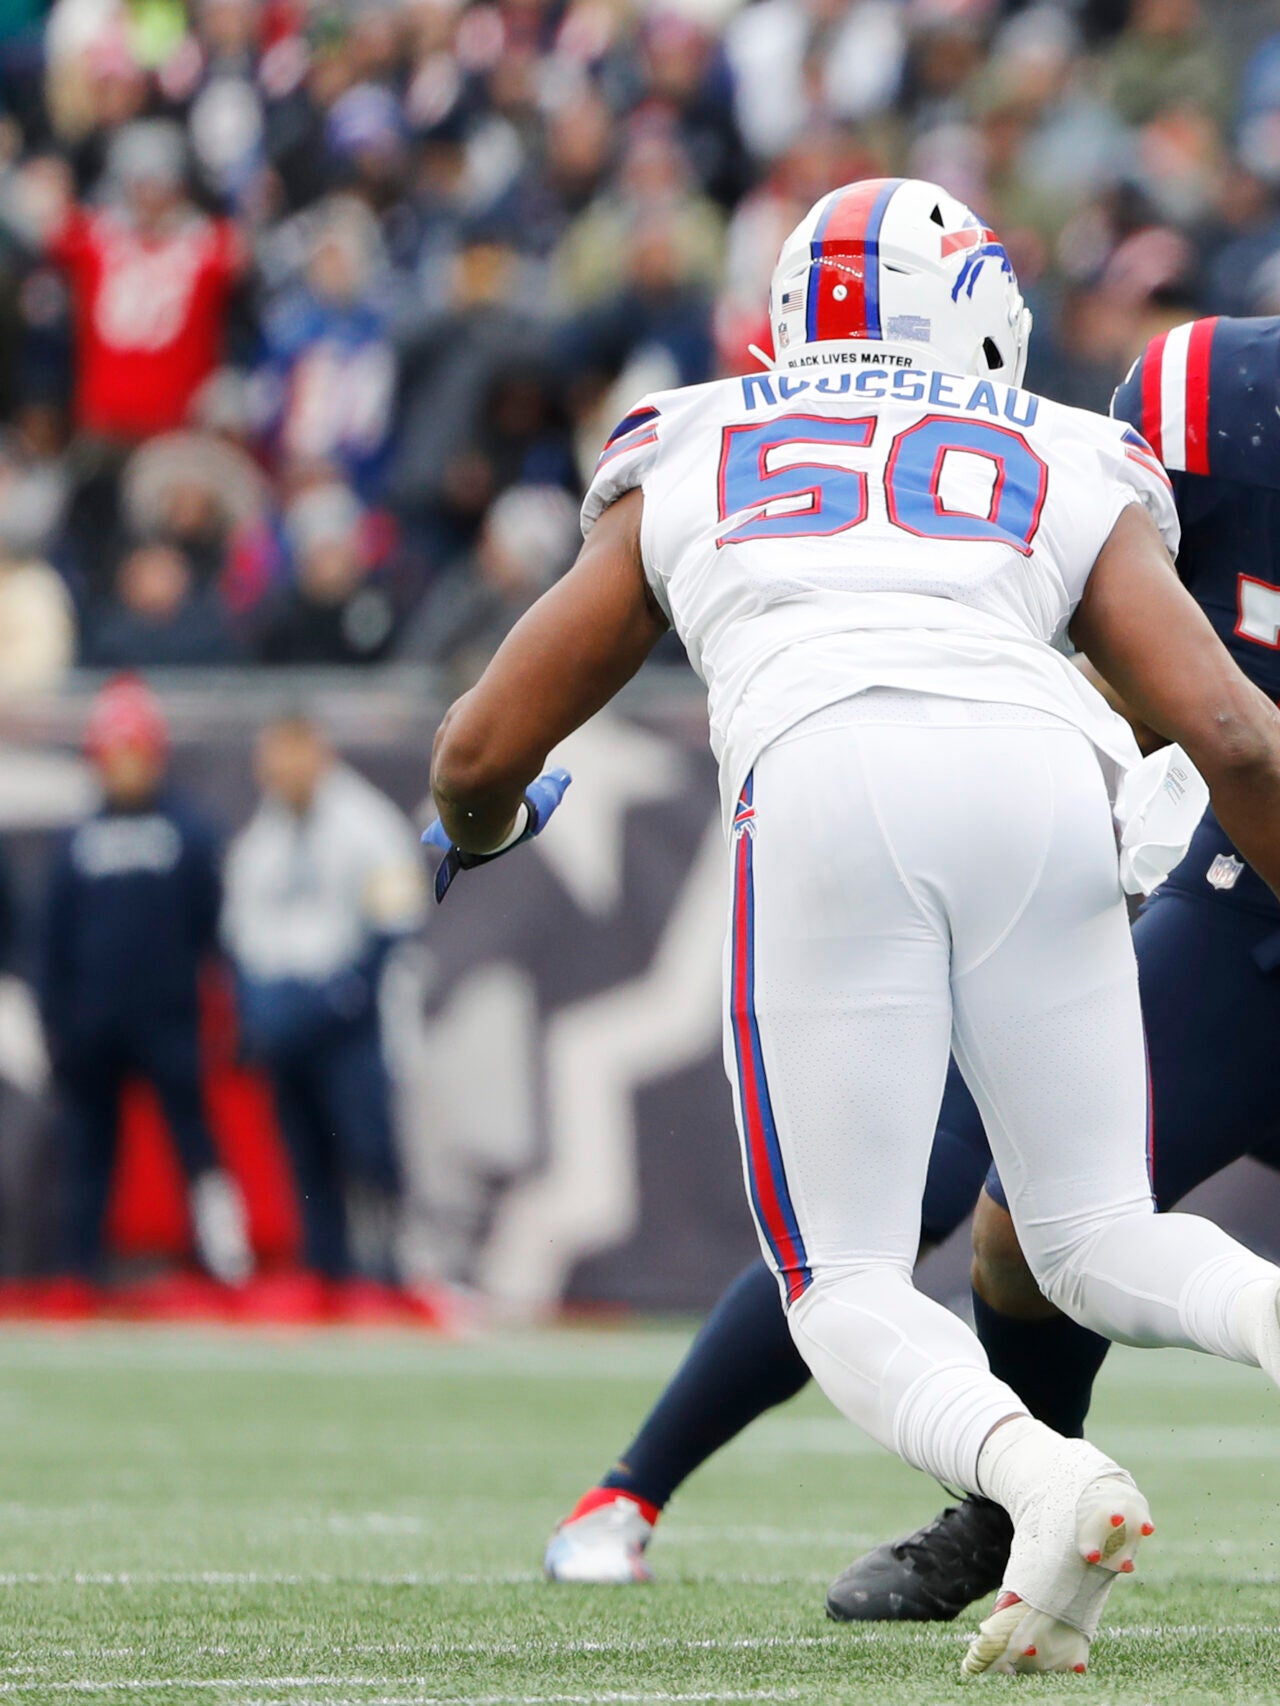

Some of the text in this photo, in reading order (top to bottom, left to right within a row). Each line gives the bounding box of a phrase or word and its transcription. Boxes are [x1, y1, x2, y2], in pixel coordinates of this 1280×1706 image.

[788, 353, 913, 369] BLACK LIVES MATTER
[716, 413, 1049, 557] 50
